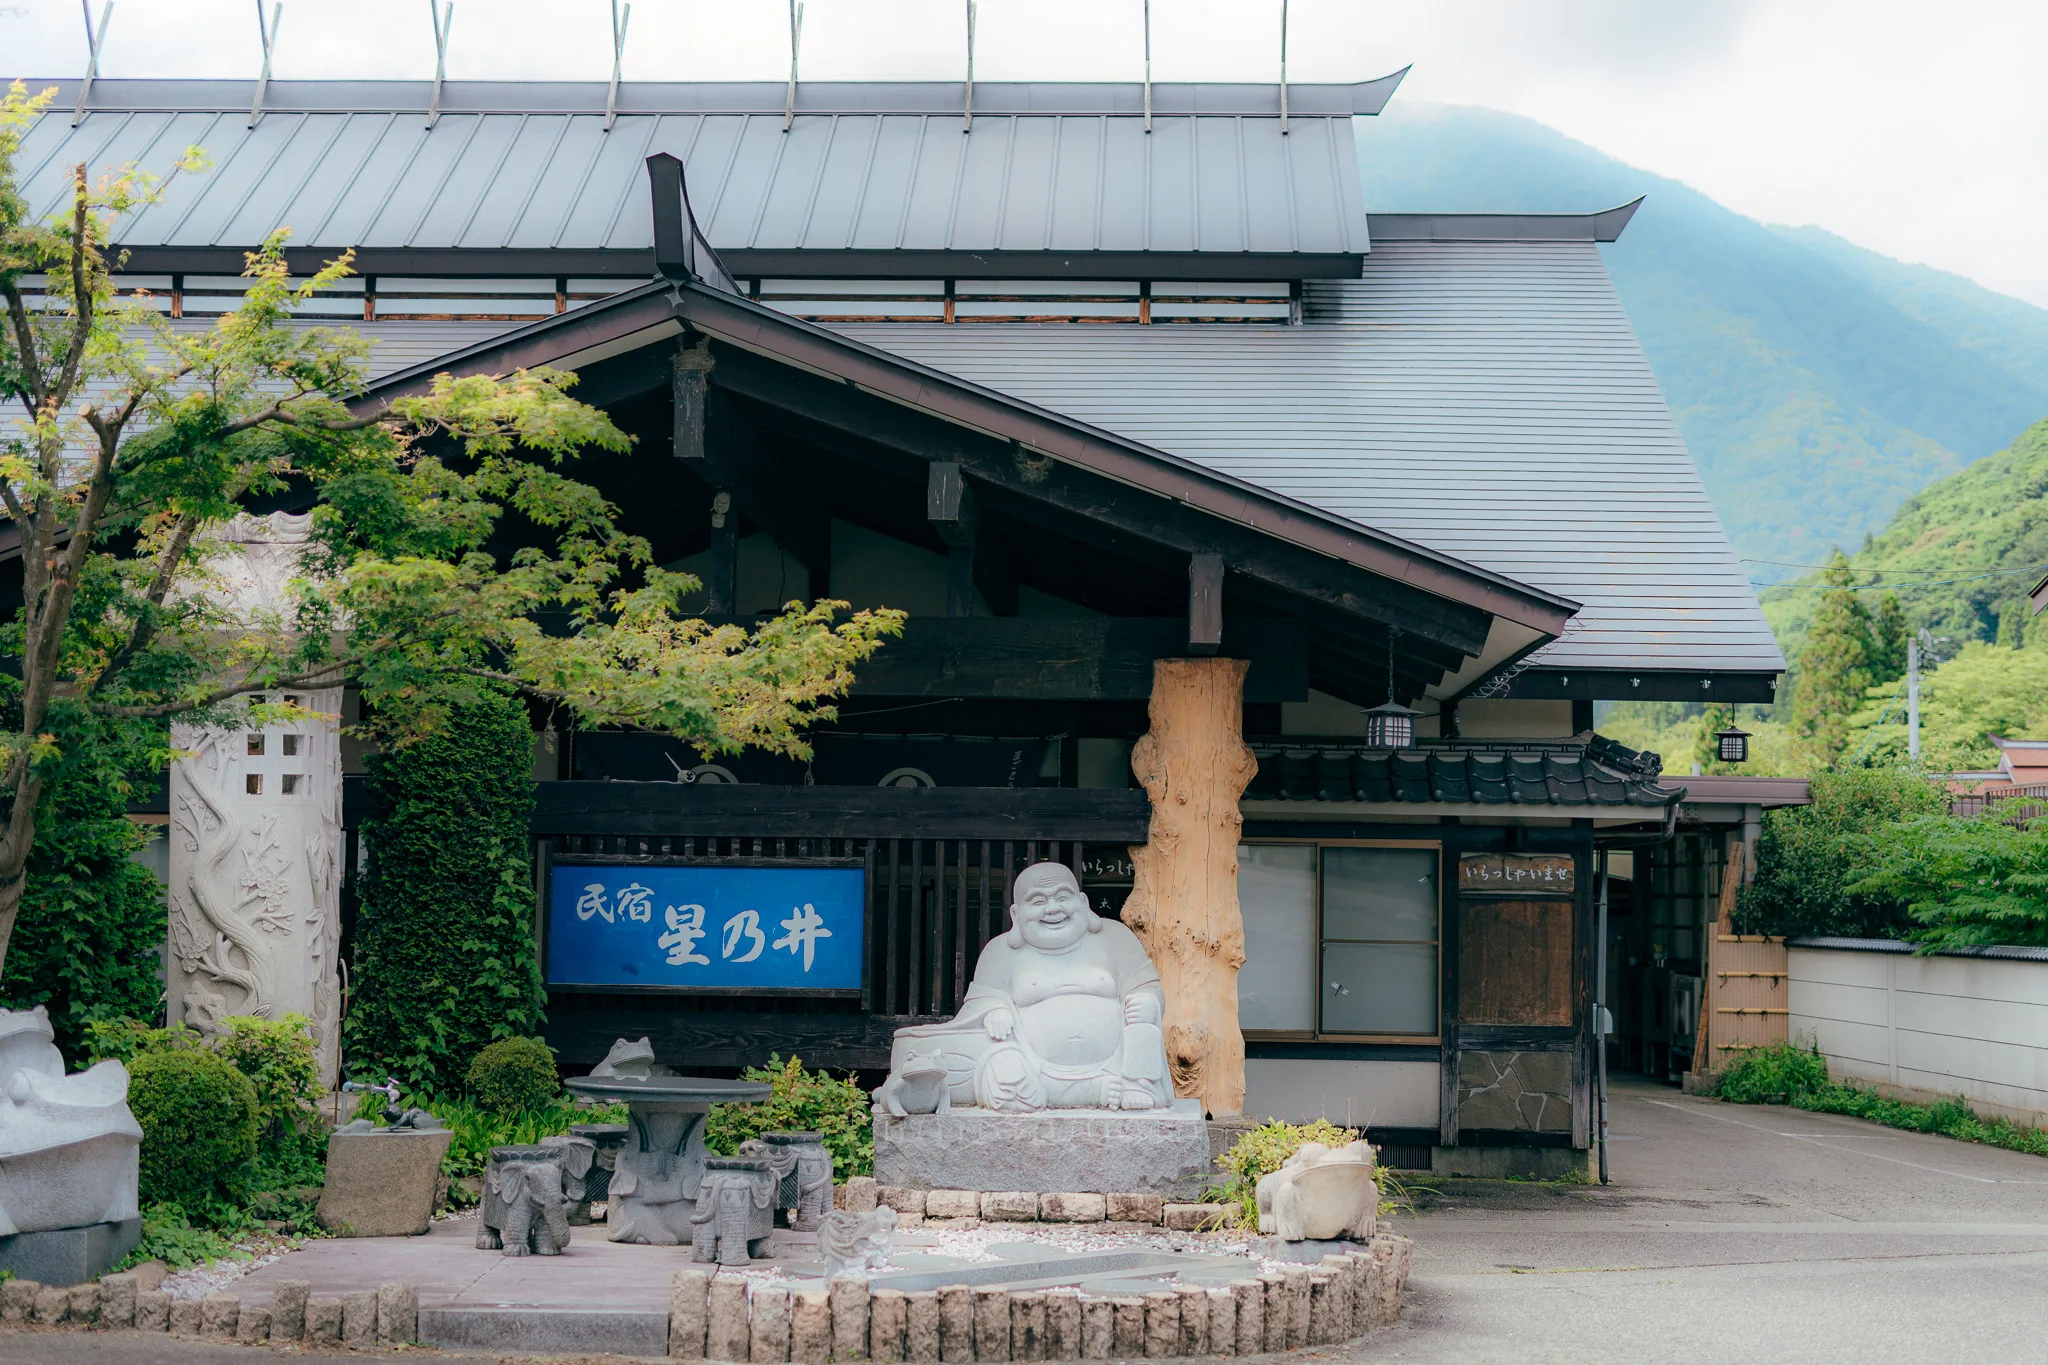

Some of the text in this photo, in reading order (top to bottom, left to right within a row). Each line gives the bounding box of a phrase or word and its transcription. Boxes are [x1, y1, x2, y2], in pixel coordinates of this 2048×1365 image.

[1465, 864, 1569, 882] いらっしゃいませ
[576, 882, 833, 973] 民宿 星乃井
